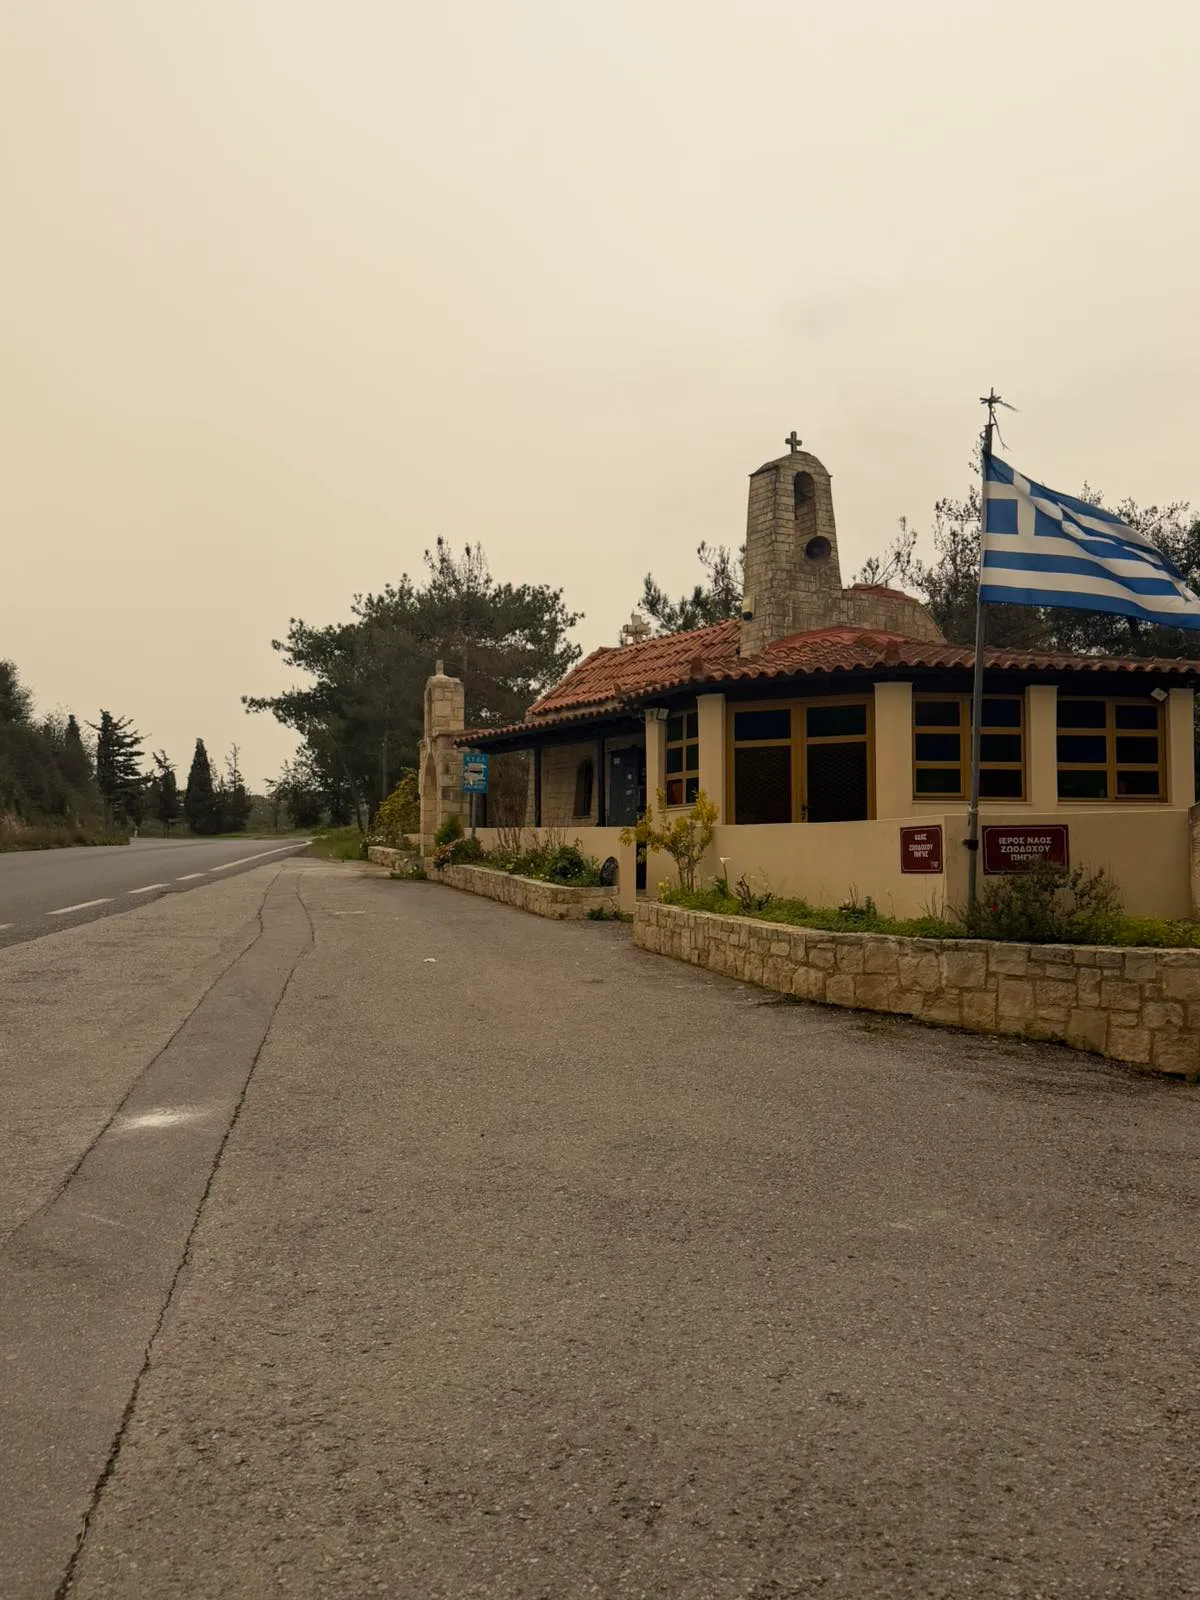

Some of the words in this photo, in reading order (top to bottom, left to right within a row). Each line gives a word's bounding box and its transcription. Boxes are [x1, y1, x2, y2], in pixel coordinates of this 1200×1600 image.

[998, 836, 1025, 845] ΙΕΡΟΣ
[1026, 836, 1053, 845] ΝΑΟΣ
[1000, 845, 1051, 853] ΖΩΟΔΟΧΟΥ
